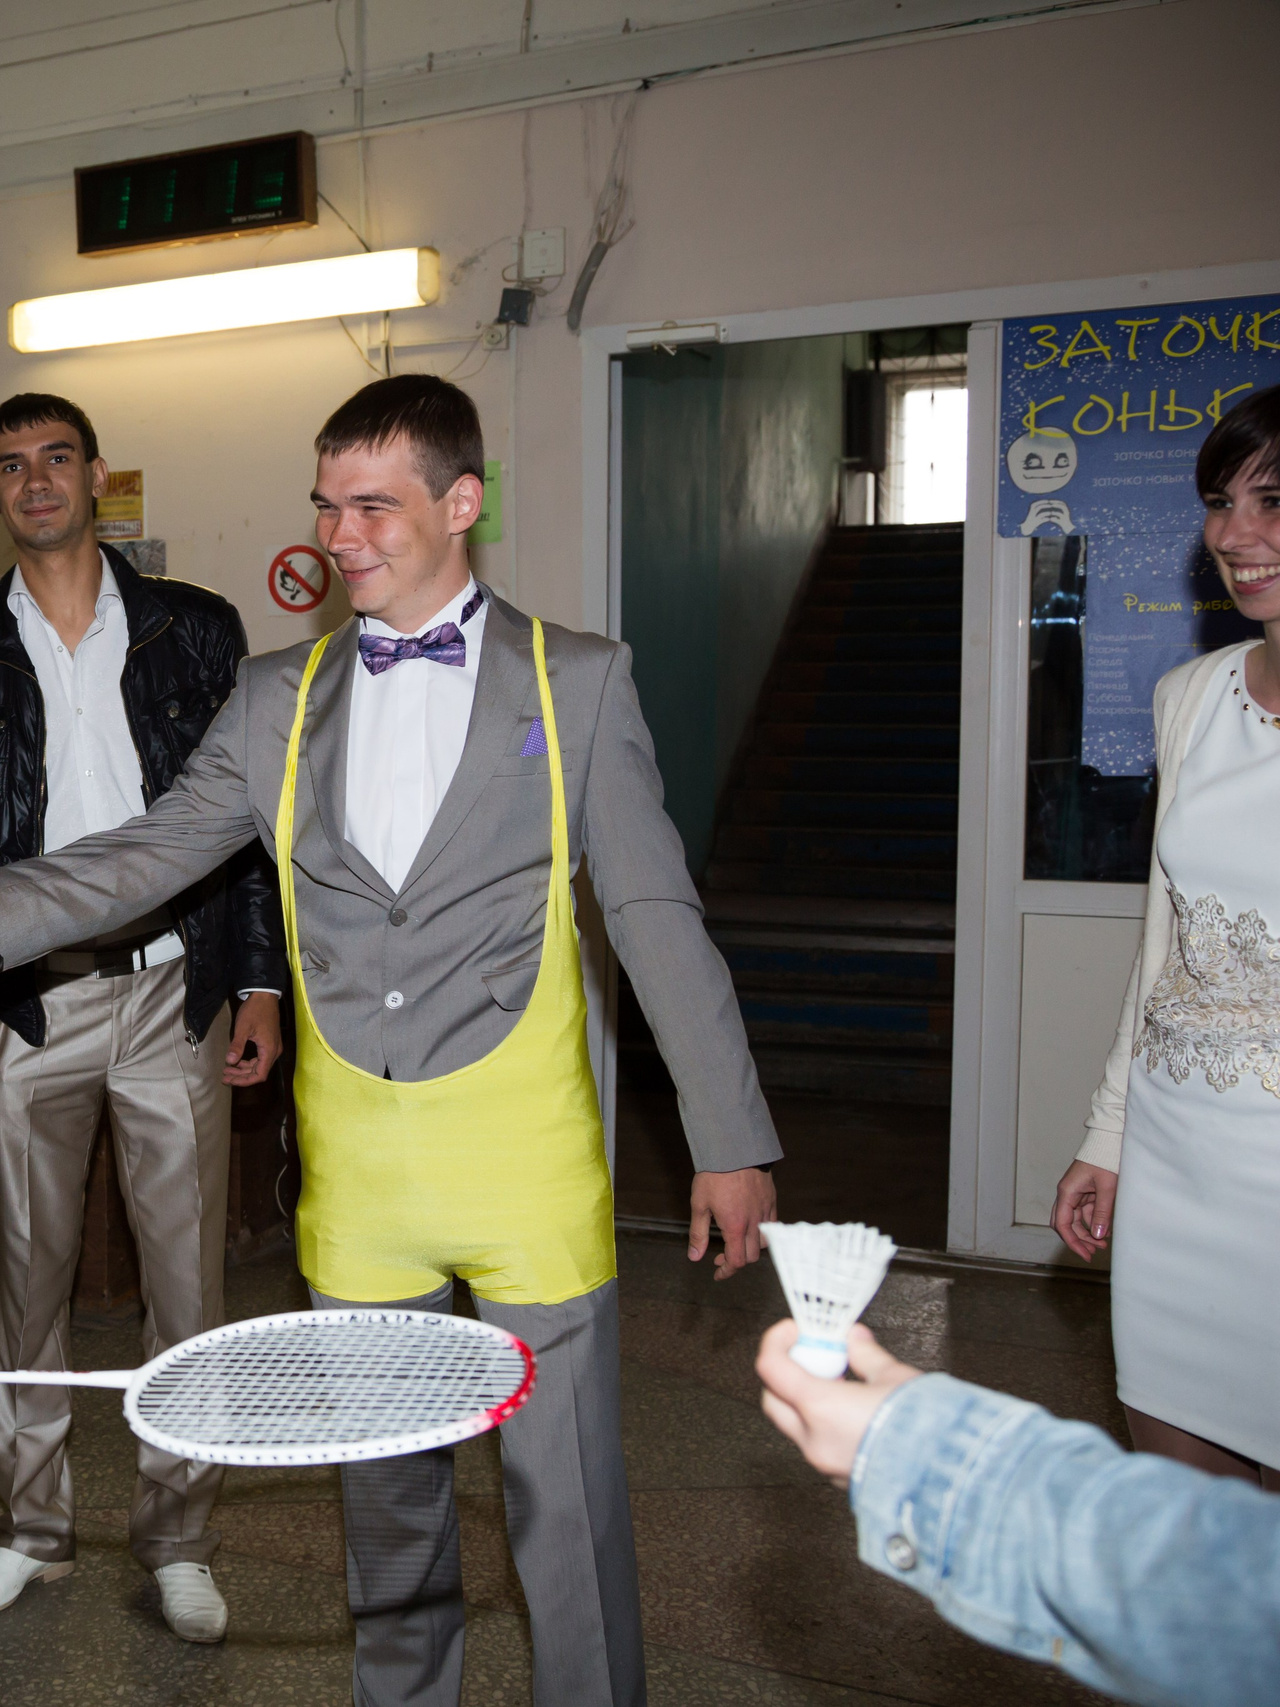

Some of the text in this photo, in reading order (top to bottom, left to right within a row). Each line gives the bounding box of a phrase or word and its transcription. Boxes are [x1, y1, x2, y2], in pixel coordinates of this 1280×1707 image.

[1113, 450, 1164, 462] заточка
[1092, 475, 1142, 487] заточка
[1146, 474, 1185, 484] новых
[1086, 693, 1132, 704] Суббота
